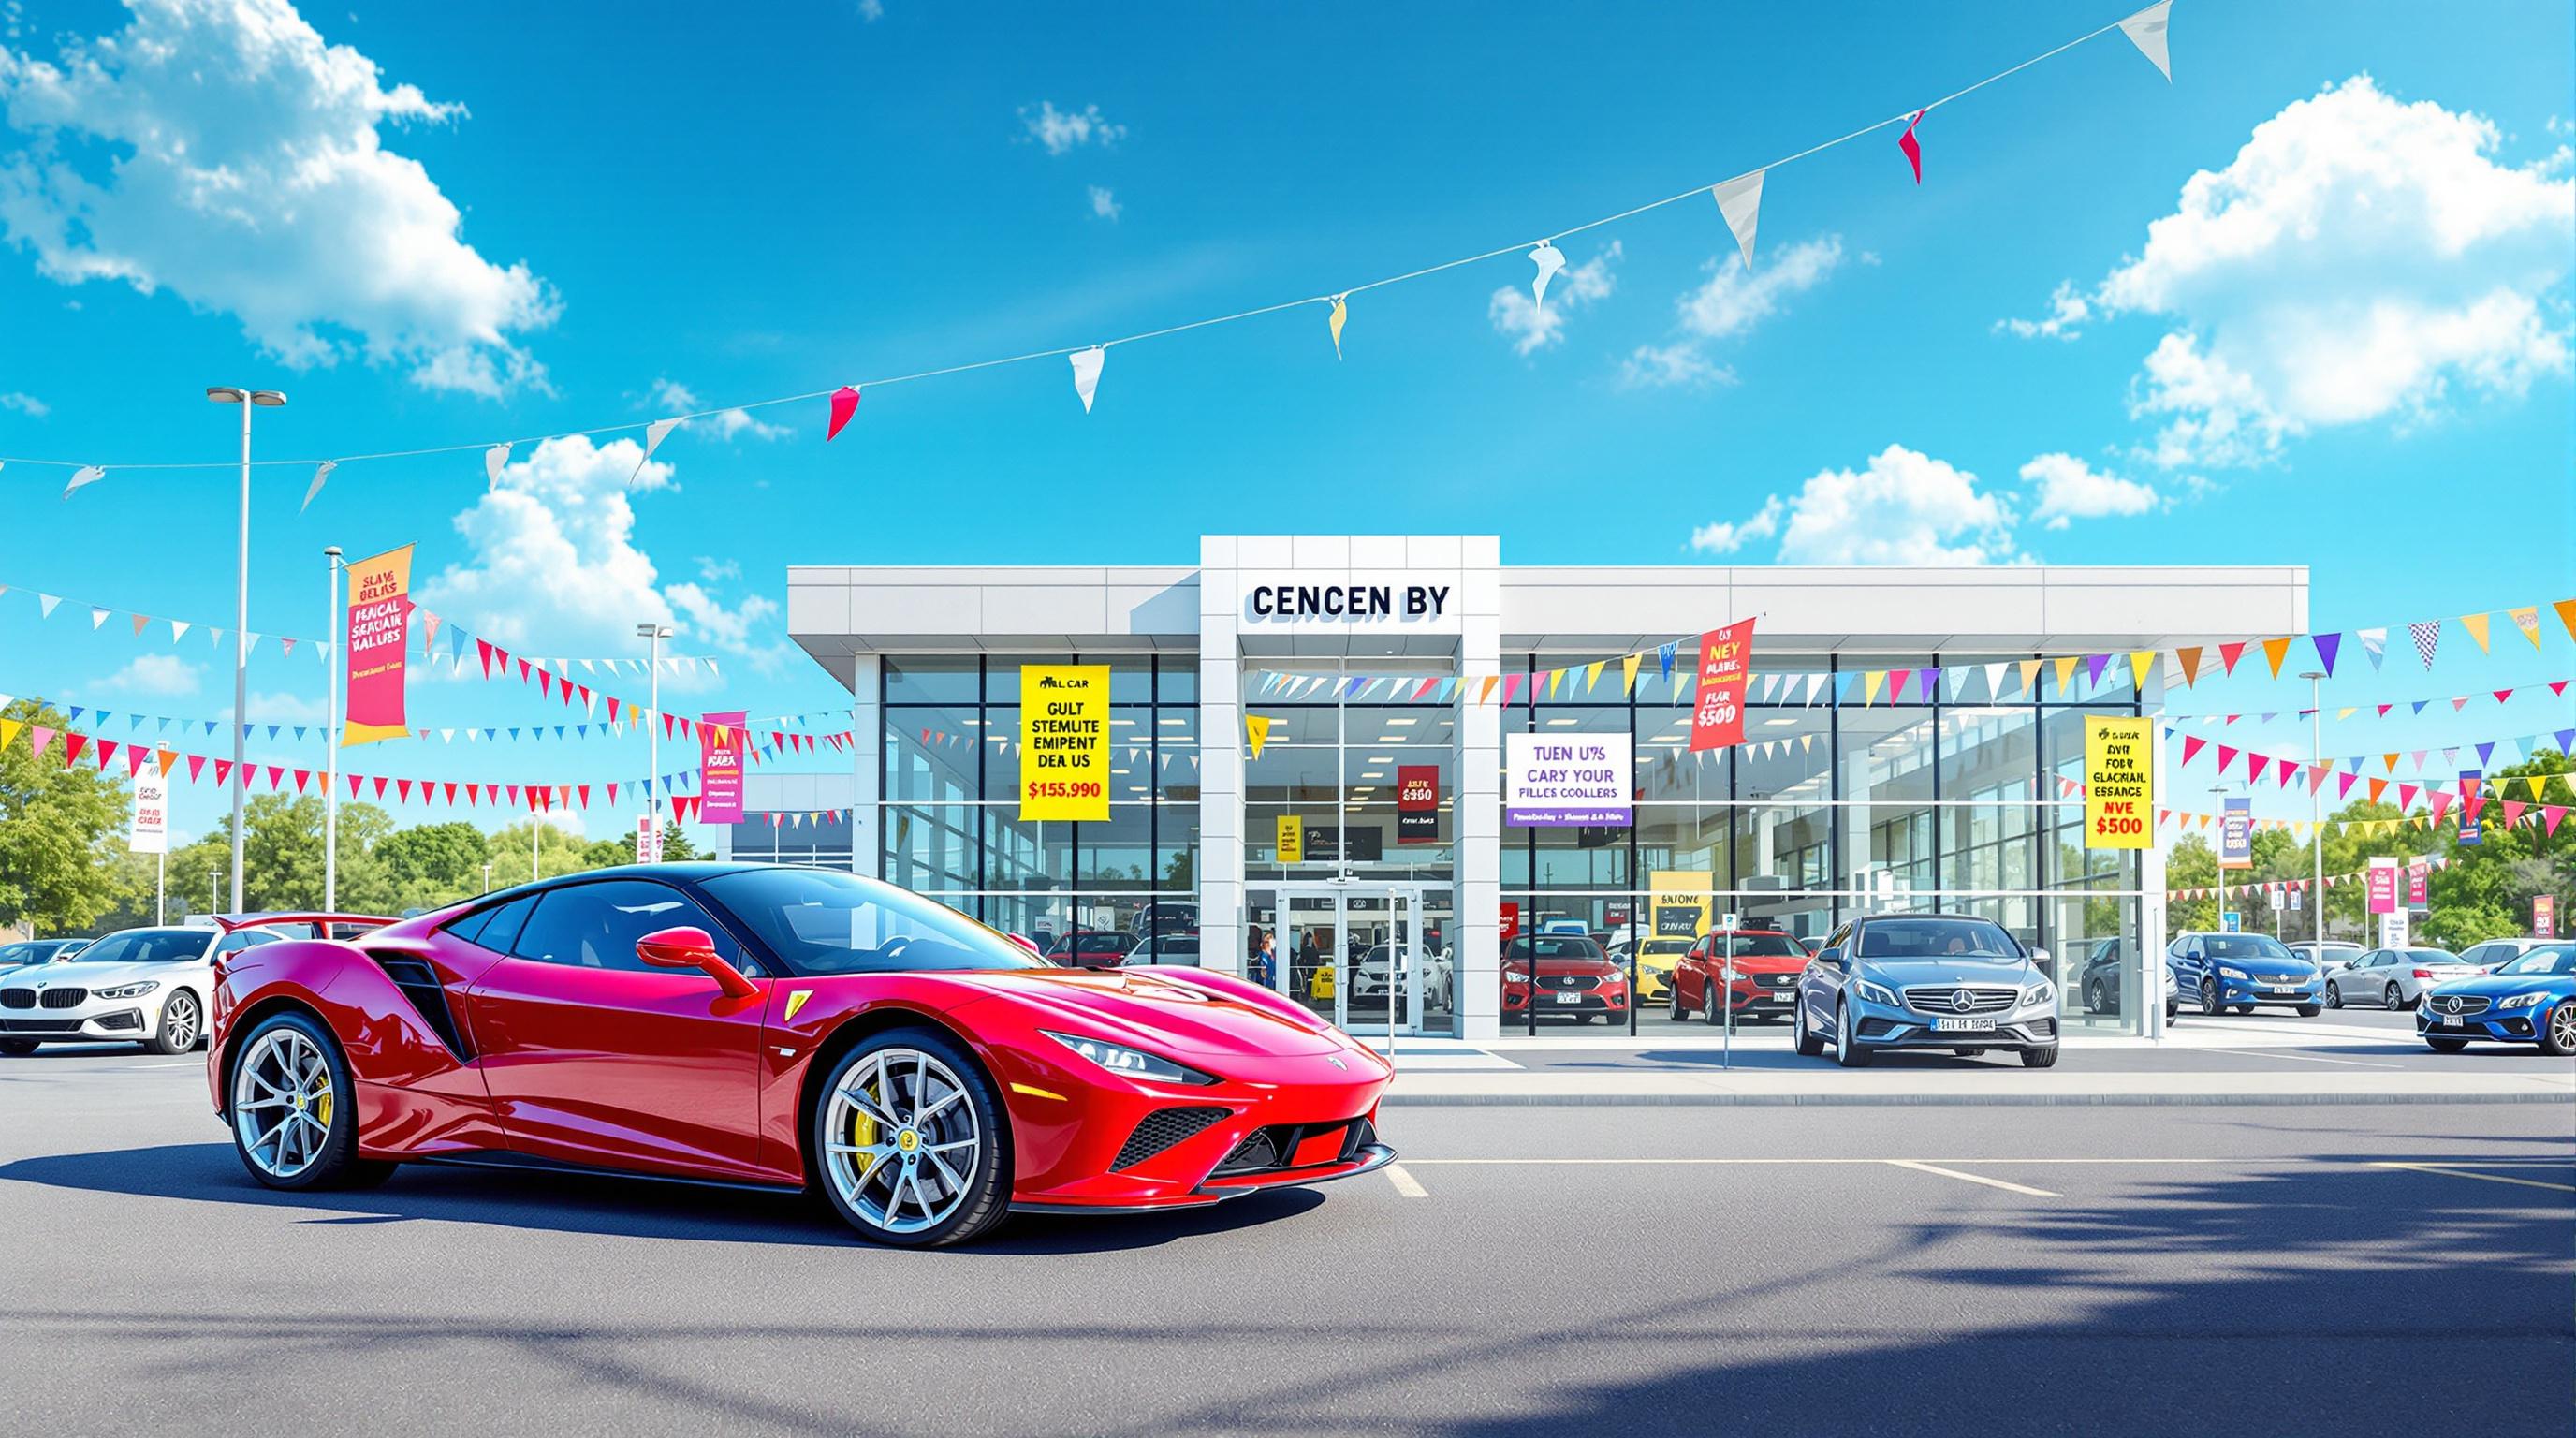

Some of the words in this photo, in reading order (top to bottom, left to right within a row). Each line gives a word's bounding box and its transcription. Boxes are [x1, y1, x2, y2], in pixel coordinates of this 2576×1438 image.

[1253, 586, 1391, 615] CENCEN
[1406, 586, 1450, 615] BY
[1067, 679, 1089, 689] CAR
[1047, 701, 1084, 716] GULT
[1698, 704, 1737, 728] $500
[1033, 736, 1098, 750] EMIPENT
[1533, 746, 1573, 761] TUEN
[1071, 754, 1090, 768] US
[1573, 770, 1614, 783] YOUR
[2104, 802, 2134, 814] NVE
[2096, 816, 2143, 836] $500
